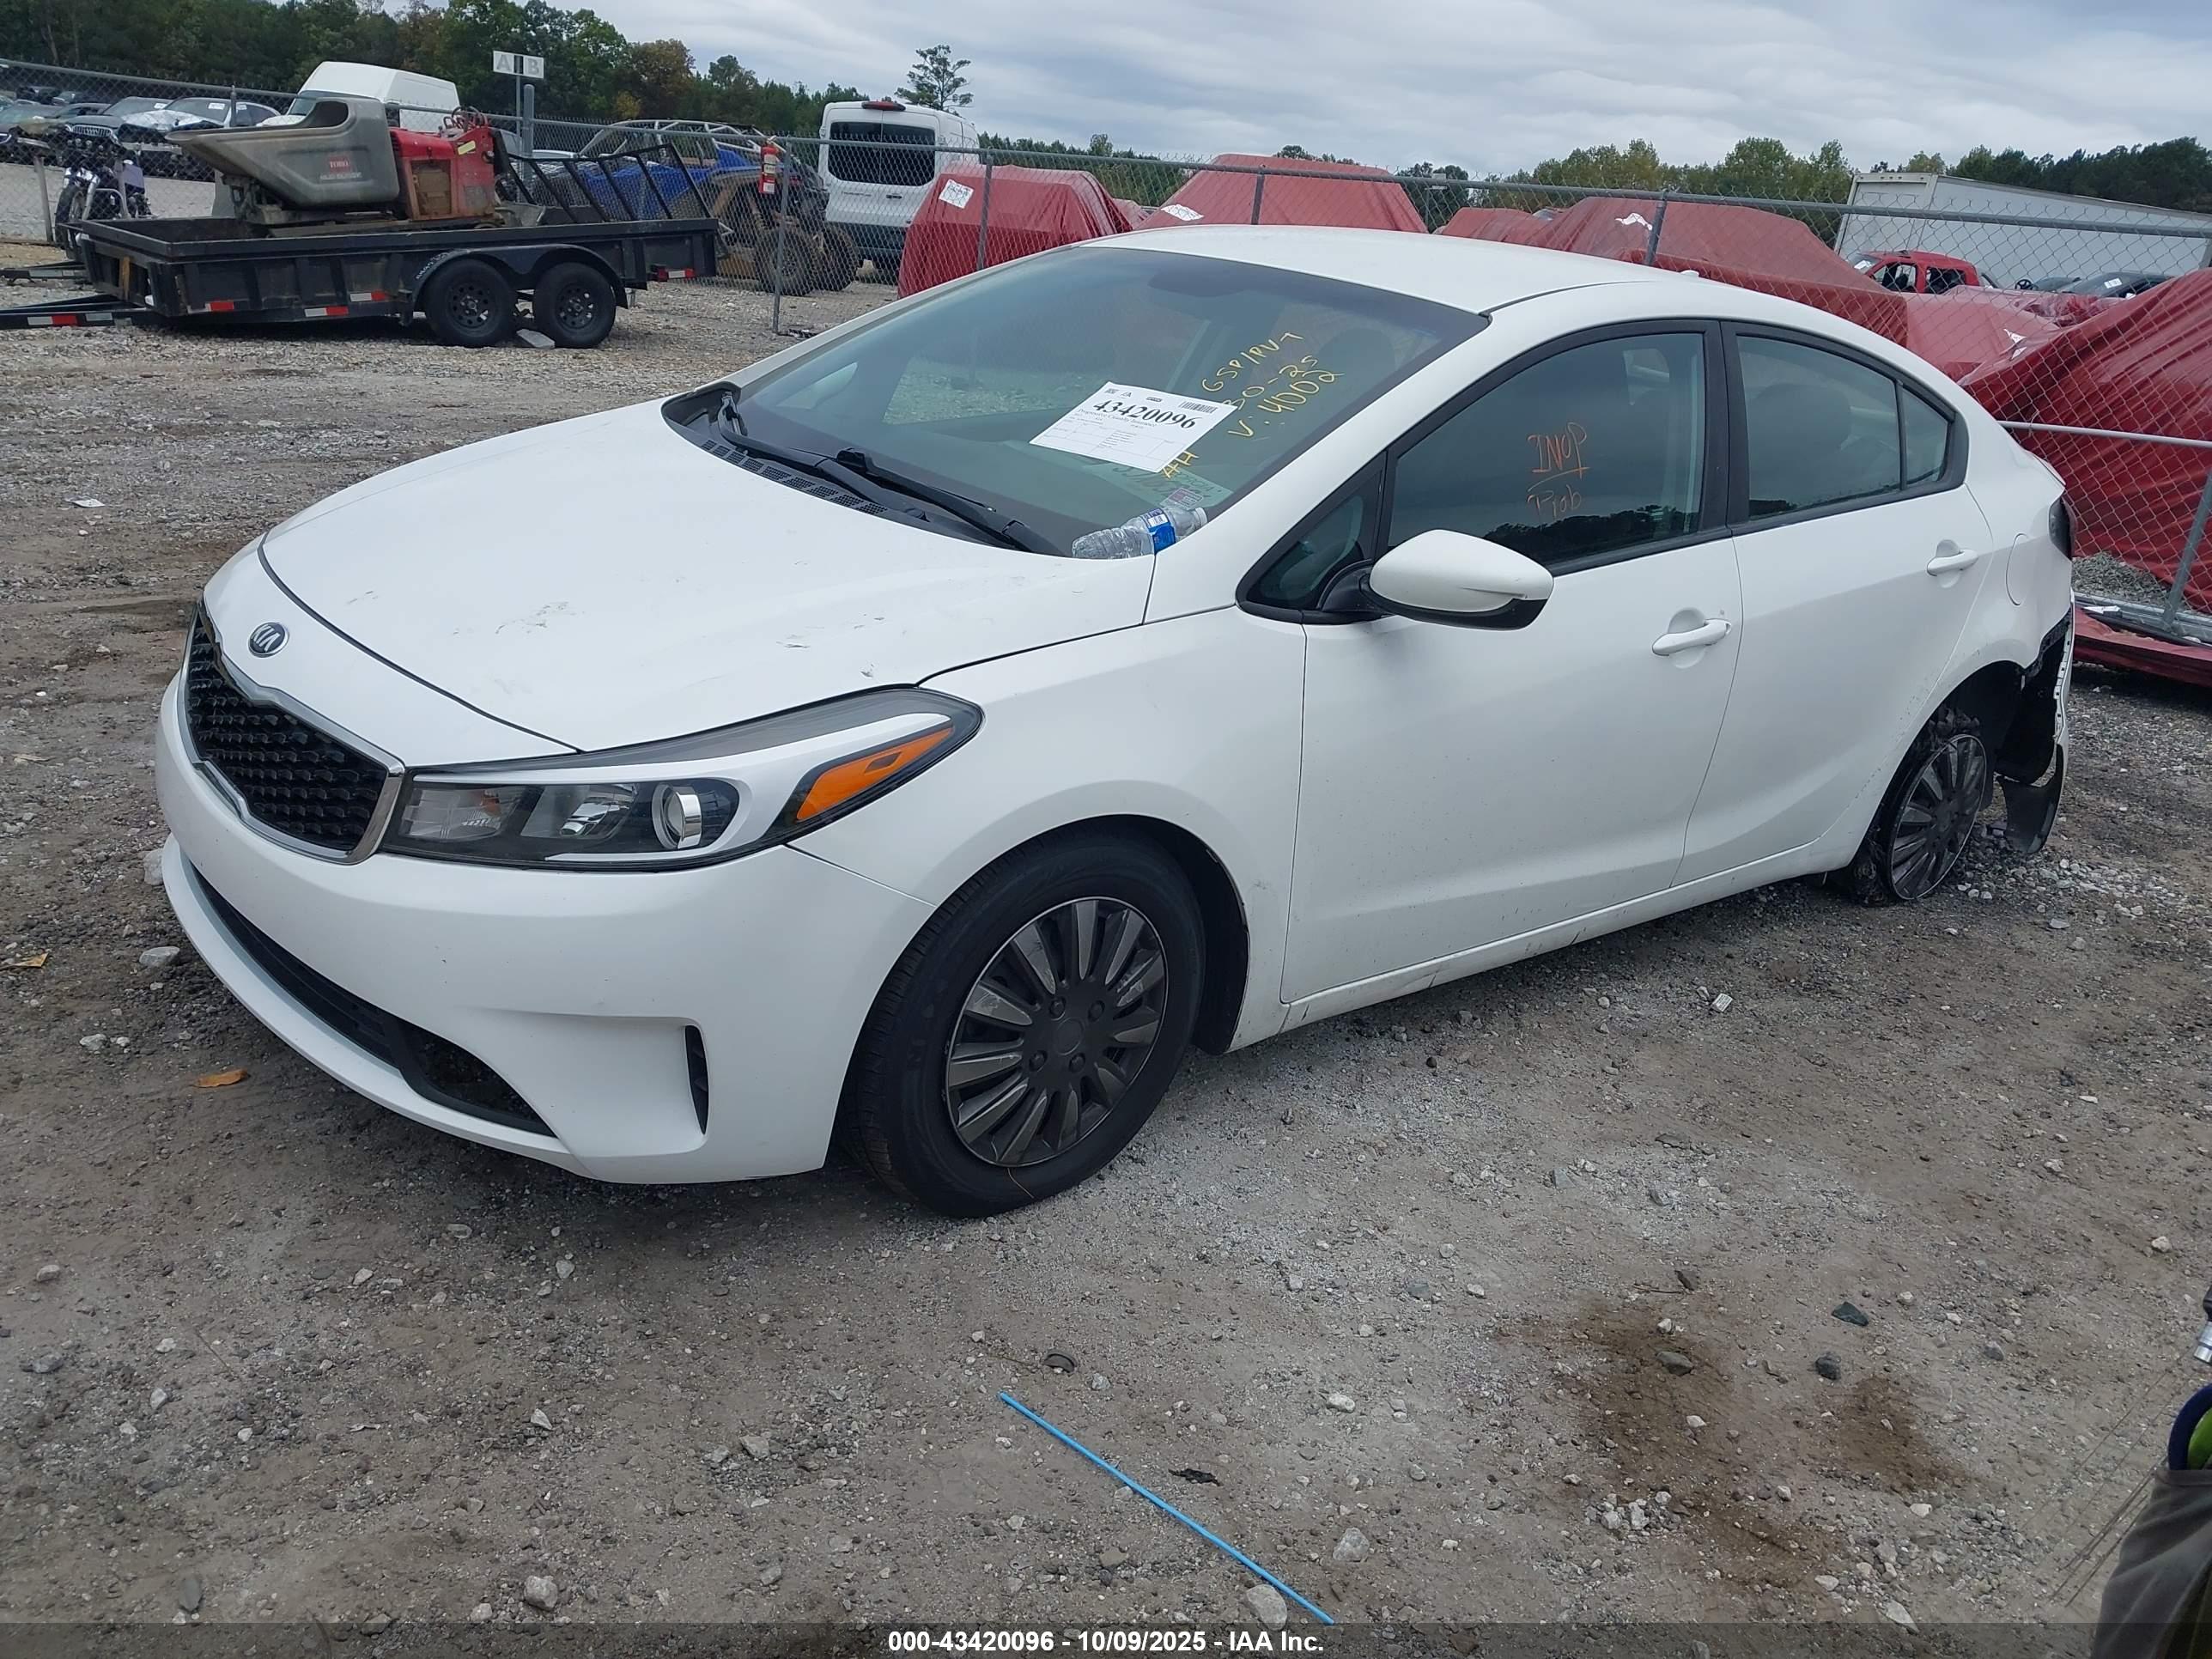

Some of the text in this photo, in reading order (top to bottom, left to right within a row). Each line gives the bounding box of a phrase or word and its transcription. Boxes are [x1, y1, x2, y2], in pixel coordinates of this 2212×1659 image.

[496, 54, 540, 75] A B
[1093, 399, 1202, 429] 43420096
[1528, 422, 1587, 479] INOP
[252, 623, 281, 653] KIA
